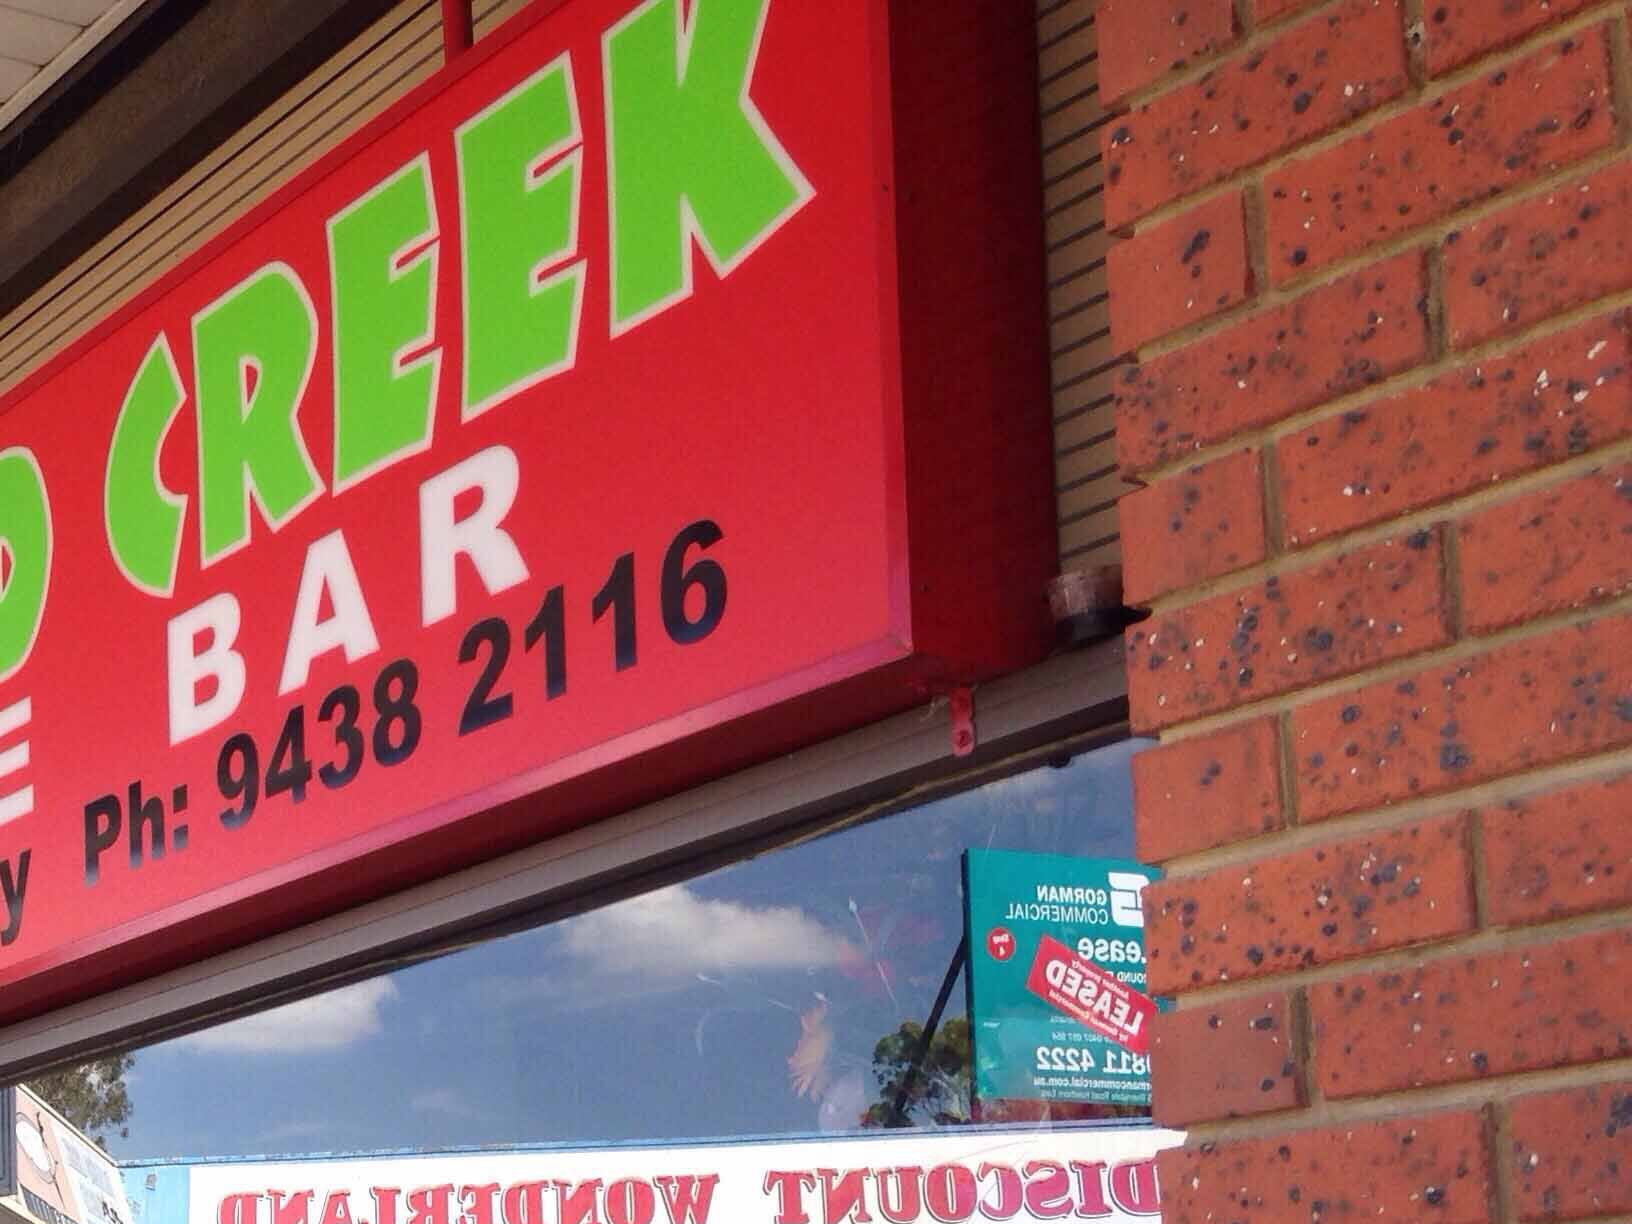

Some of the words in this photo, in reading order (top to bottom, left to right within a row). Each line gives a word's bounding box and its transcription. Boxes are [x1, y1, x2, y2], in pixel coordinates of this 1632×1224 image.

[103, 0, 818, 600] CREEK
[82, 779, 189, 887] Ph:
[217, 657, 421, 831] 9438
[457, 519, 729, 735] 2116
[167, 443, 531, 747] BAR
